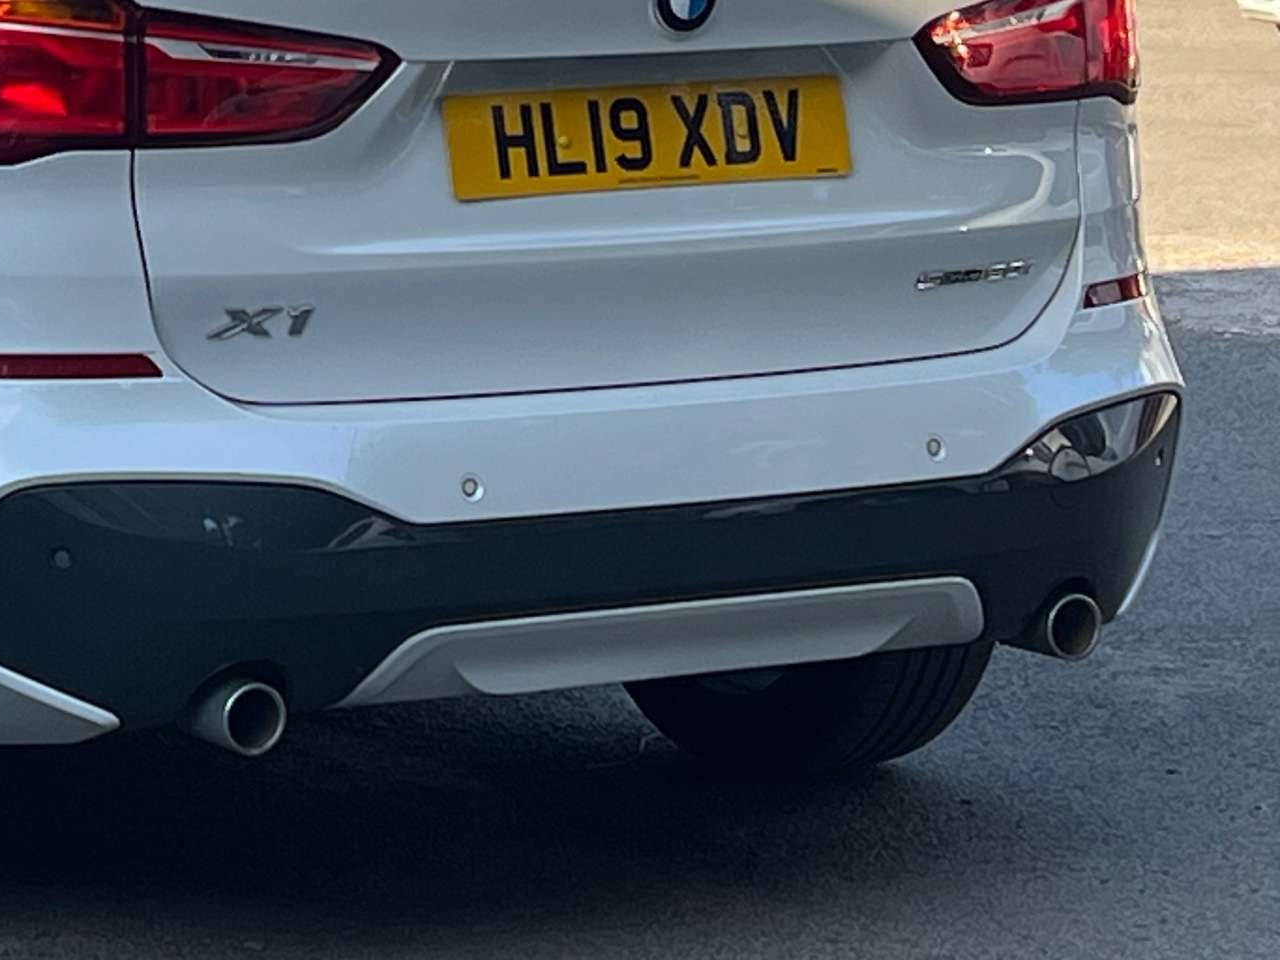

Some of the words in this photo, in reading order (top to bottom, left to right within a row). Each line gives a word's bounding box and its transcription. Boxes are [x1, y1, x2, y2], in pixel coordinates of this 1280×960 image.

[491, 97, 653, 180] HL19
[671, 89, 799, 168] XDV
[206, 305, 315, 340] X1
